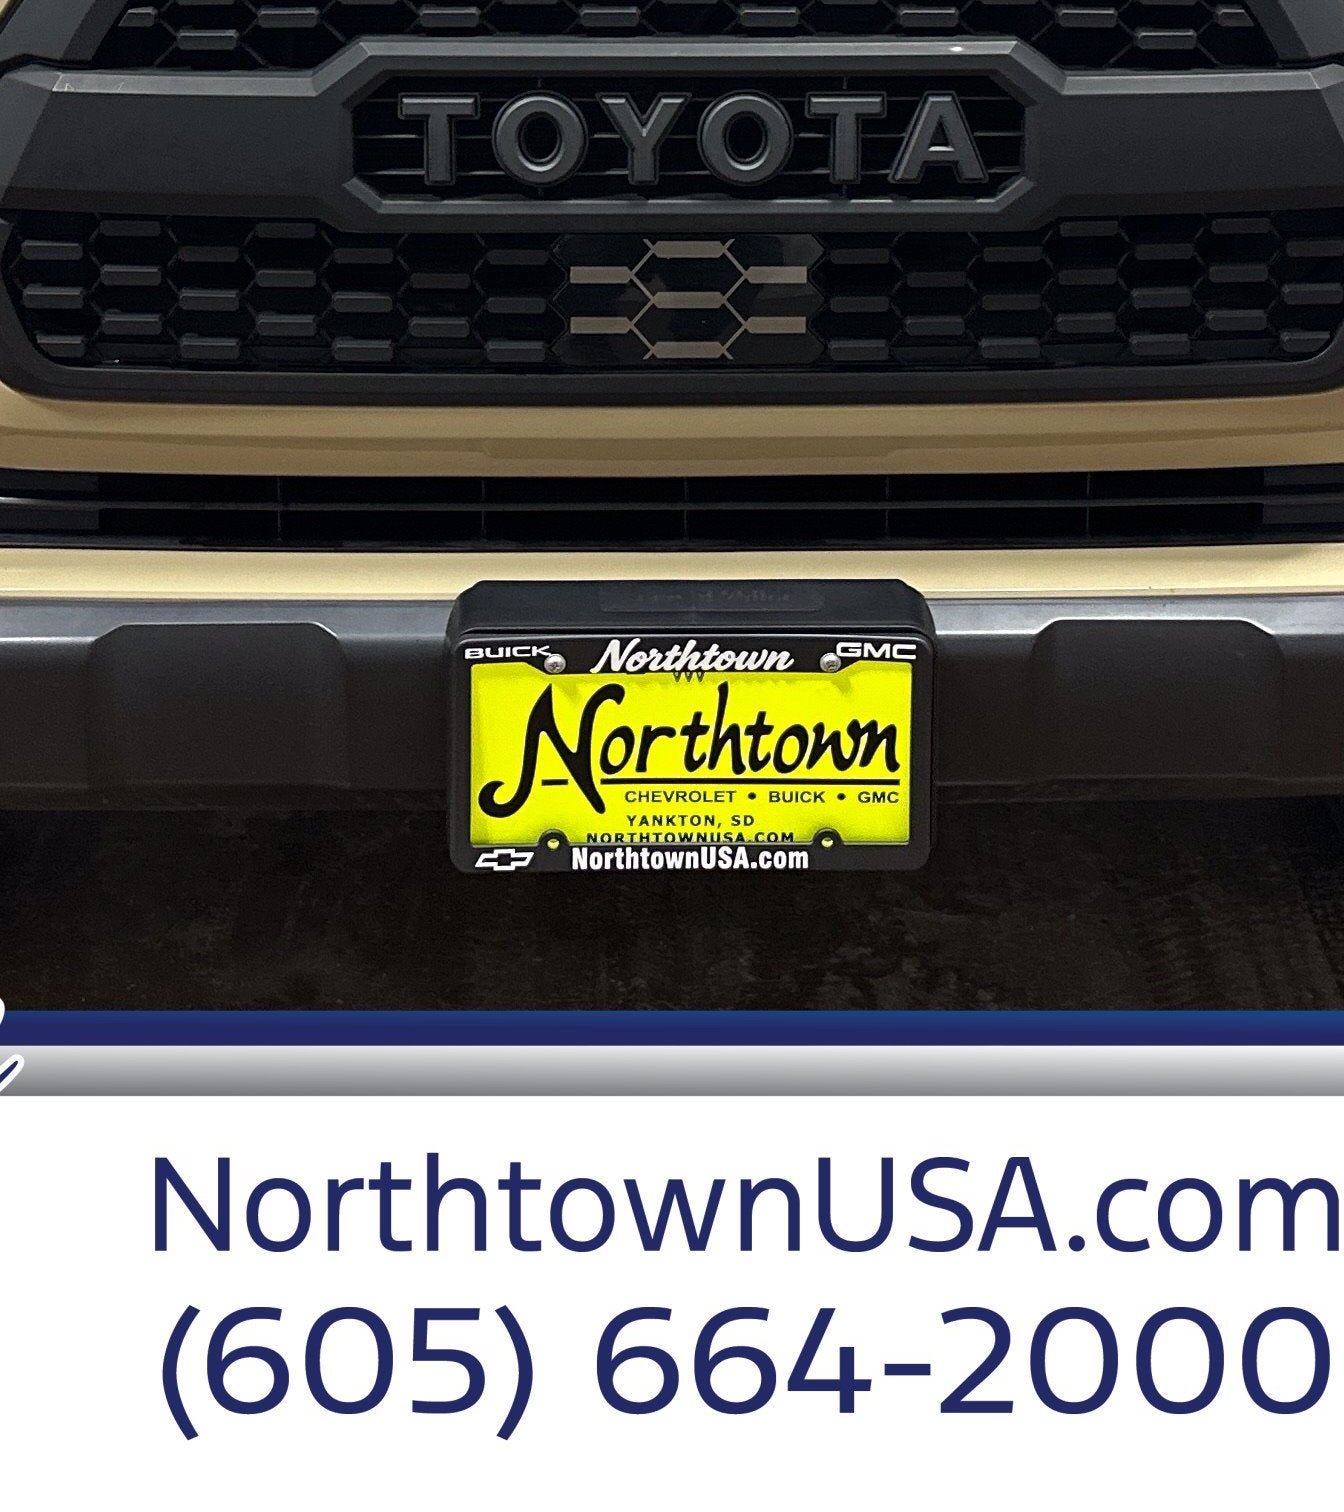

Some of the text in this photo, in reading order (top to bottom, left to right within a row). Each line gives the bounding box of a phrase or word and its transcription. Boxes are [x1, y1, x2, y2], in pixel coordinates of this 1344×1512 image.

[398, 89, 990, 185] TOYOTA
[464, 645, 552, 660] BUICK
[589, 638, 795, 674] Northtown
[835, 641, 917, 661] GMC
[477, 680, 902, 819] Northtown
[624, 790, 900, 804] CHEVROLET BUICK GMC
[626, 814, 756, 828] YANKTON, SD
[585, 832, 796, 844] NORTHTOWNUSA.COM
[571, 846, 809, 871] NorthtownUSA.com
